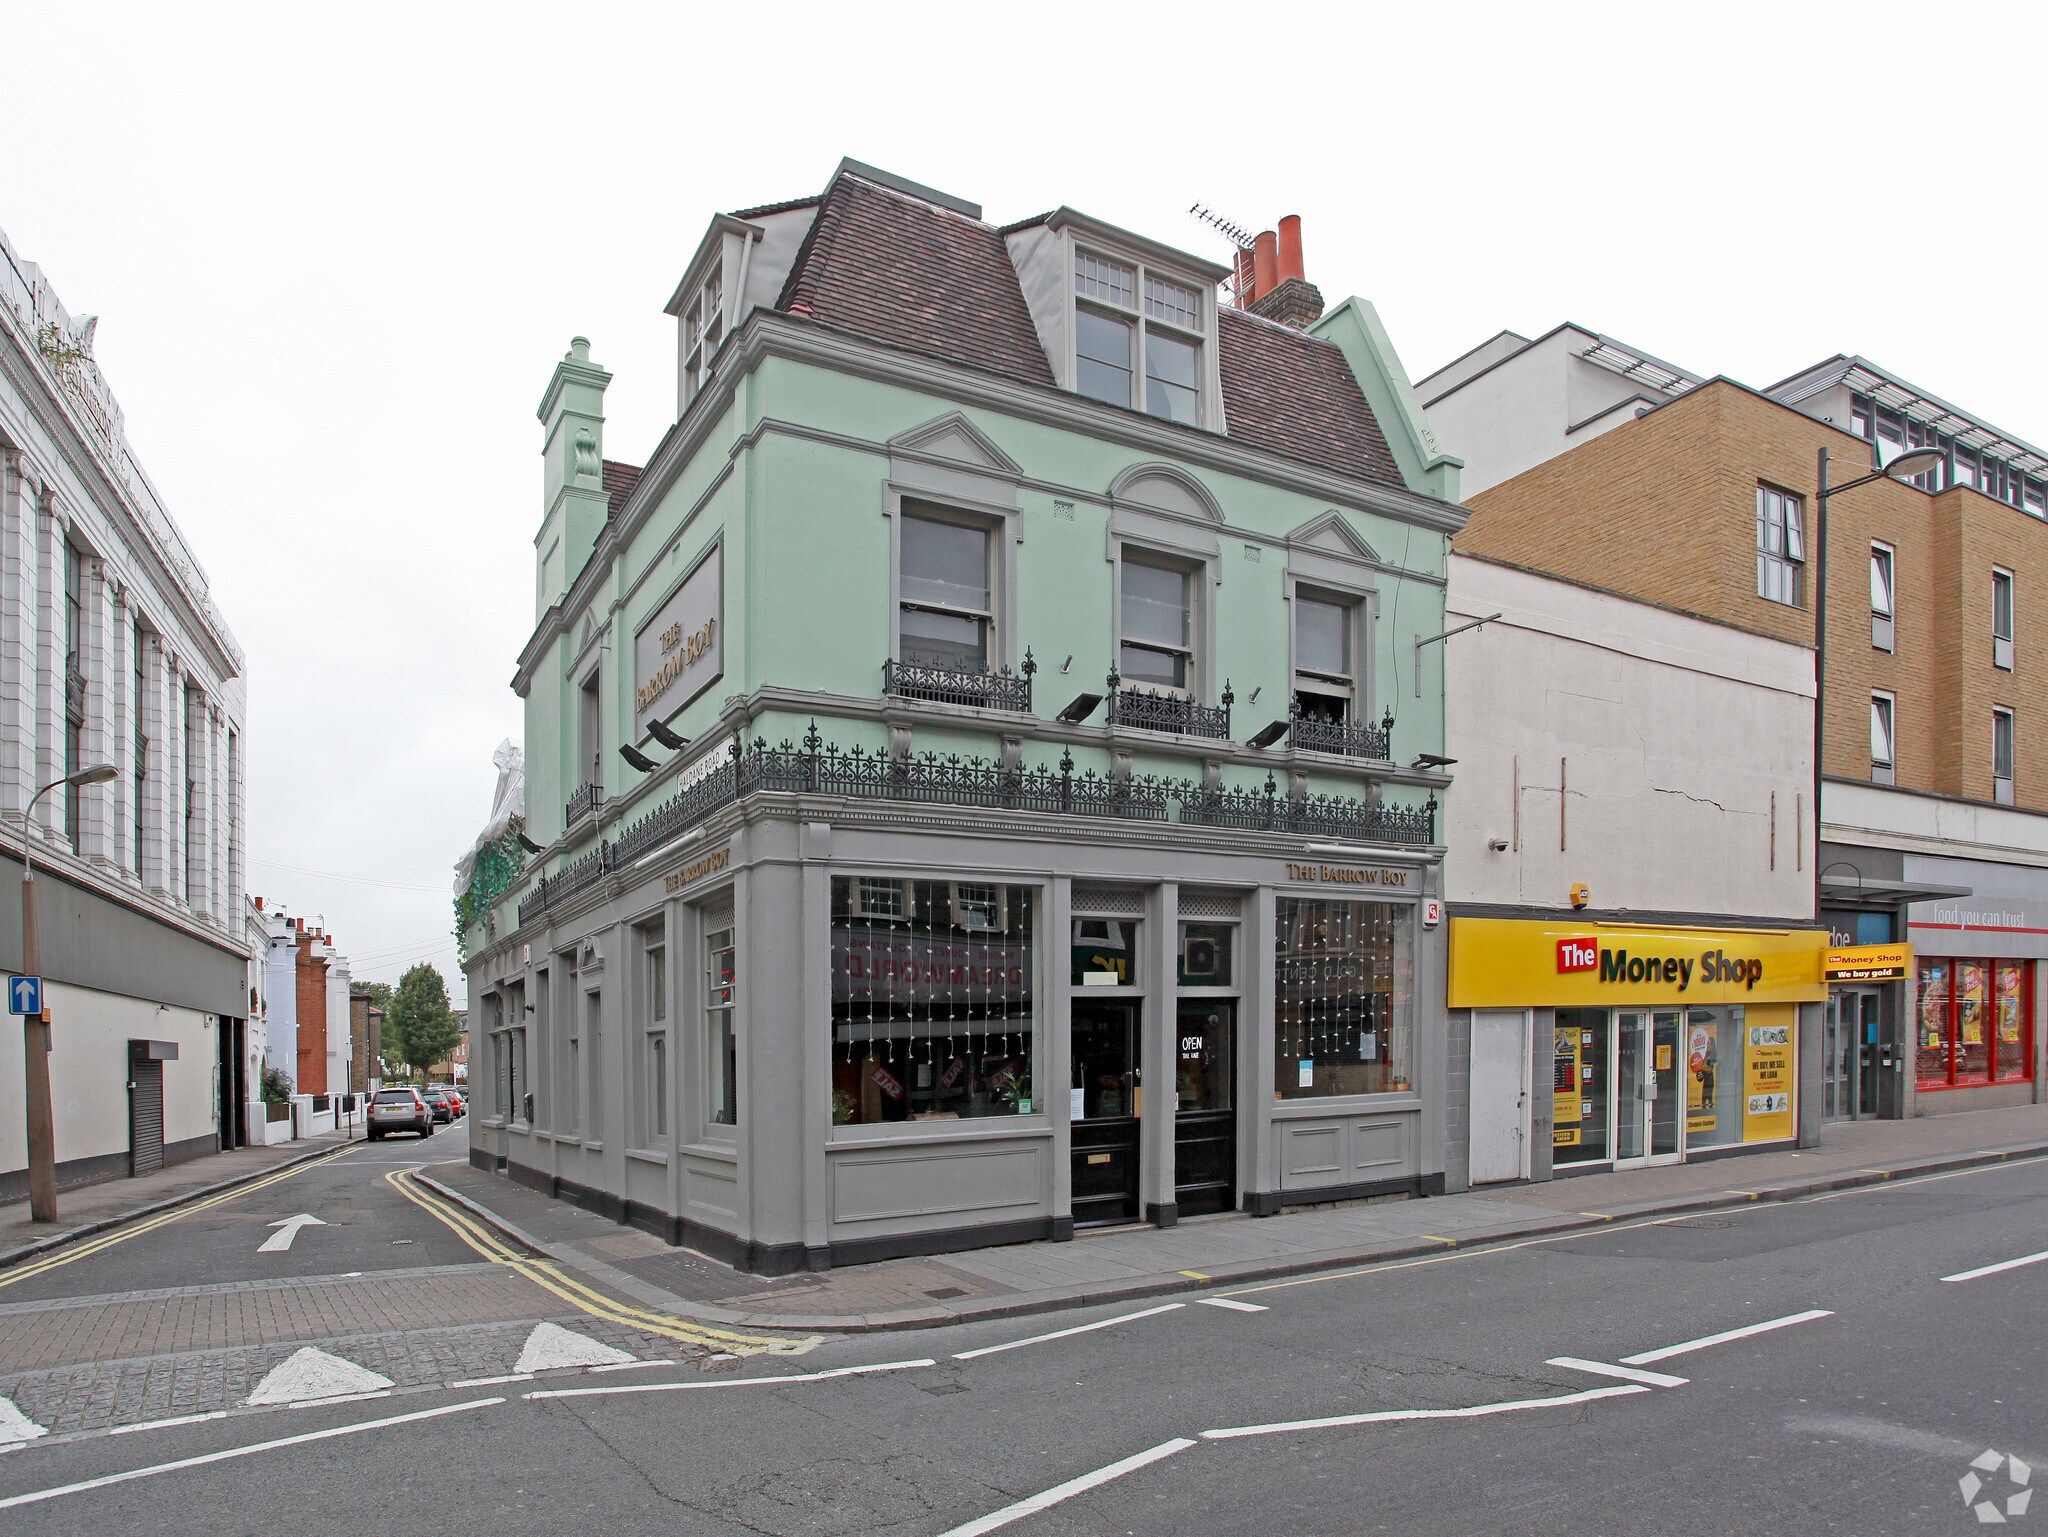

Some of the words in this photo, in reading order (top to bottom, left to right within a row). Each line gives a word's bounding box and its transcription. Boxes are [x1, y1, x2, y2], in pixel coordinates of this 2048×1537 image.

[659, 621, 681, 655] THE
[637, 648, 685, 714] BARROW
[686, 617, 715, 666] BOY
[705, 752, 719, 772] ROAD
[1286, 862, 1317, 880] THE
[1320, 865, 1378, 884] BARROW
[1382, 869, 1408, 885] BOY
[1933, 903, 1958, 923] food
[1960, 910, 1979, 930] you
[1982, 912, 2000, 927] can
[2002, 910, 2025, 928] trust
[1561, 943, 1594, 967] The
[1600, 949, 1694, 991] Money
[1701, 949, 1762, 991] Shop
[1842, 956, 1874, 964] Money
[1853, 970, 1870, 978] buy
[1871, 968, 1892, 977] gold
[1182, 1036, 1202, 1050] OPEN
[1752, 1062, 1759, 1070] WE
[1776, 1060, 1785, 1068] SELL
[1767, 1071, 1778, 1079] LOAN
